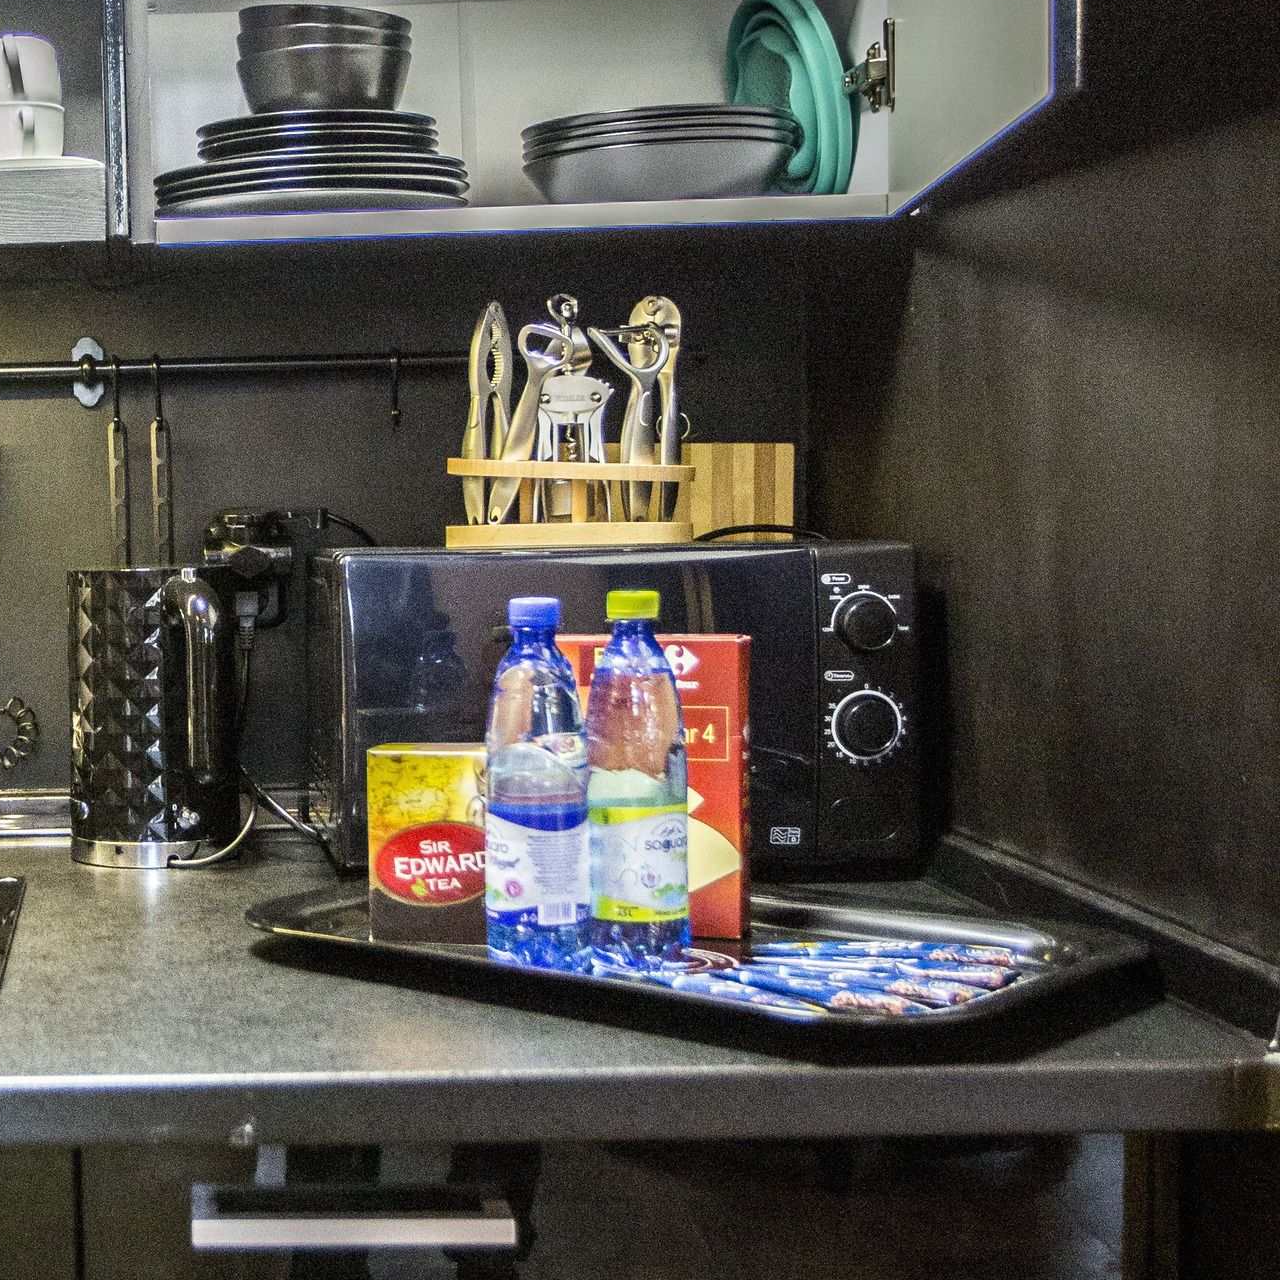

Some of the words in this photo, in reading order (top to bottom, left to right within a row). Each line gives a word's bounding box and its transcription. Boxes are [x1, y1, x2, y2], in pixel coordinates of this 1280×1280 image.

[702, 723, 715, 743] 4
[419, 840, 453, 855] SIR
[393, 851, 485, 880] EDWARD
[426, 877, 462, 891] TEA
